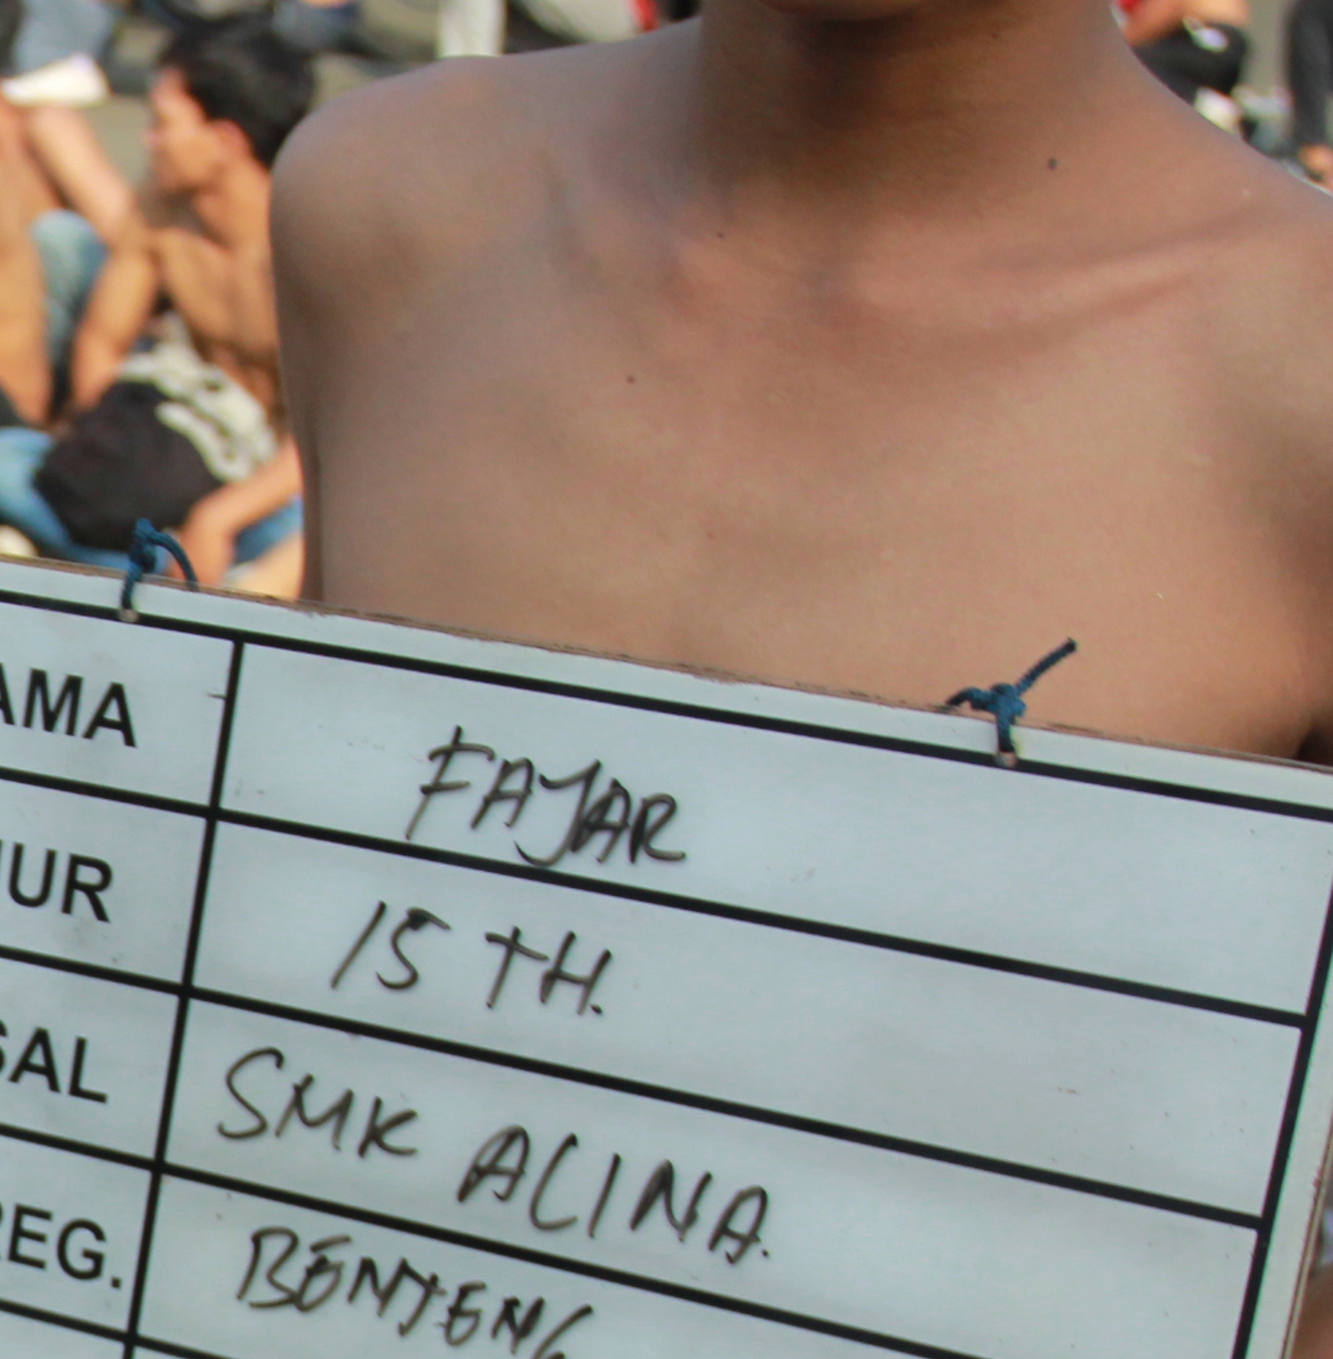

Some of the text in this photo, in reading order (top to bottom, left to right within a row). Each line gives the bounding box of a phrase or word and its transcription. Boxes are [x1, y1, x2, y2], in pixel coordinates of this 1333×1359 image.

[406, 725, 687, 868] FAJAR
[329, 900, 452, 994] 15
[216, 1045, 418, 1160] SMK
